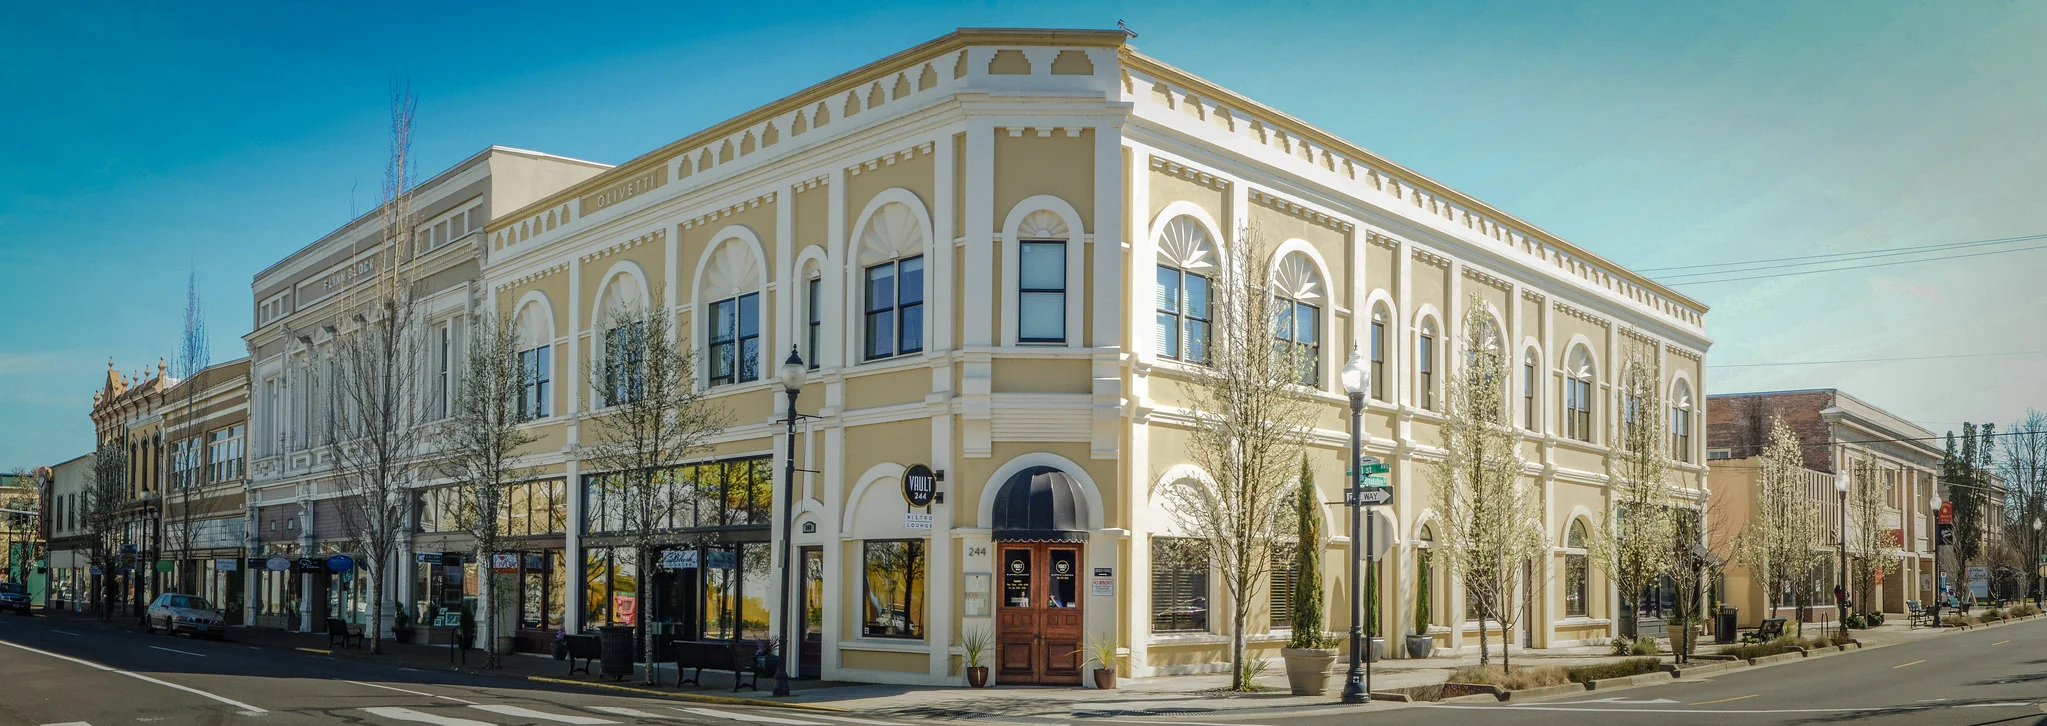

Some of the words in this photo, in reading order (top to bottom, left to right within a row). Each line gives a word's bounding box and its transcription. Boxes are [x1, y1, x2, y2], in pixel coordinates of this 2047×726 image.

[597, 174, 654, 208] OLIVETTI
[909, 475, 933, 492] VAULT
[914, 492, 927, 500] 244
[1364, 492, 1378, 500] WAY
[968, 547, 986, 557] 244
